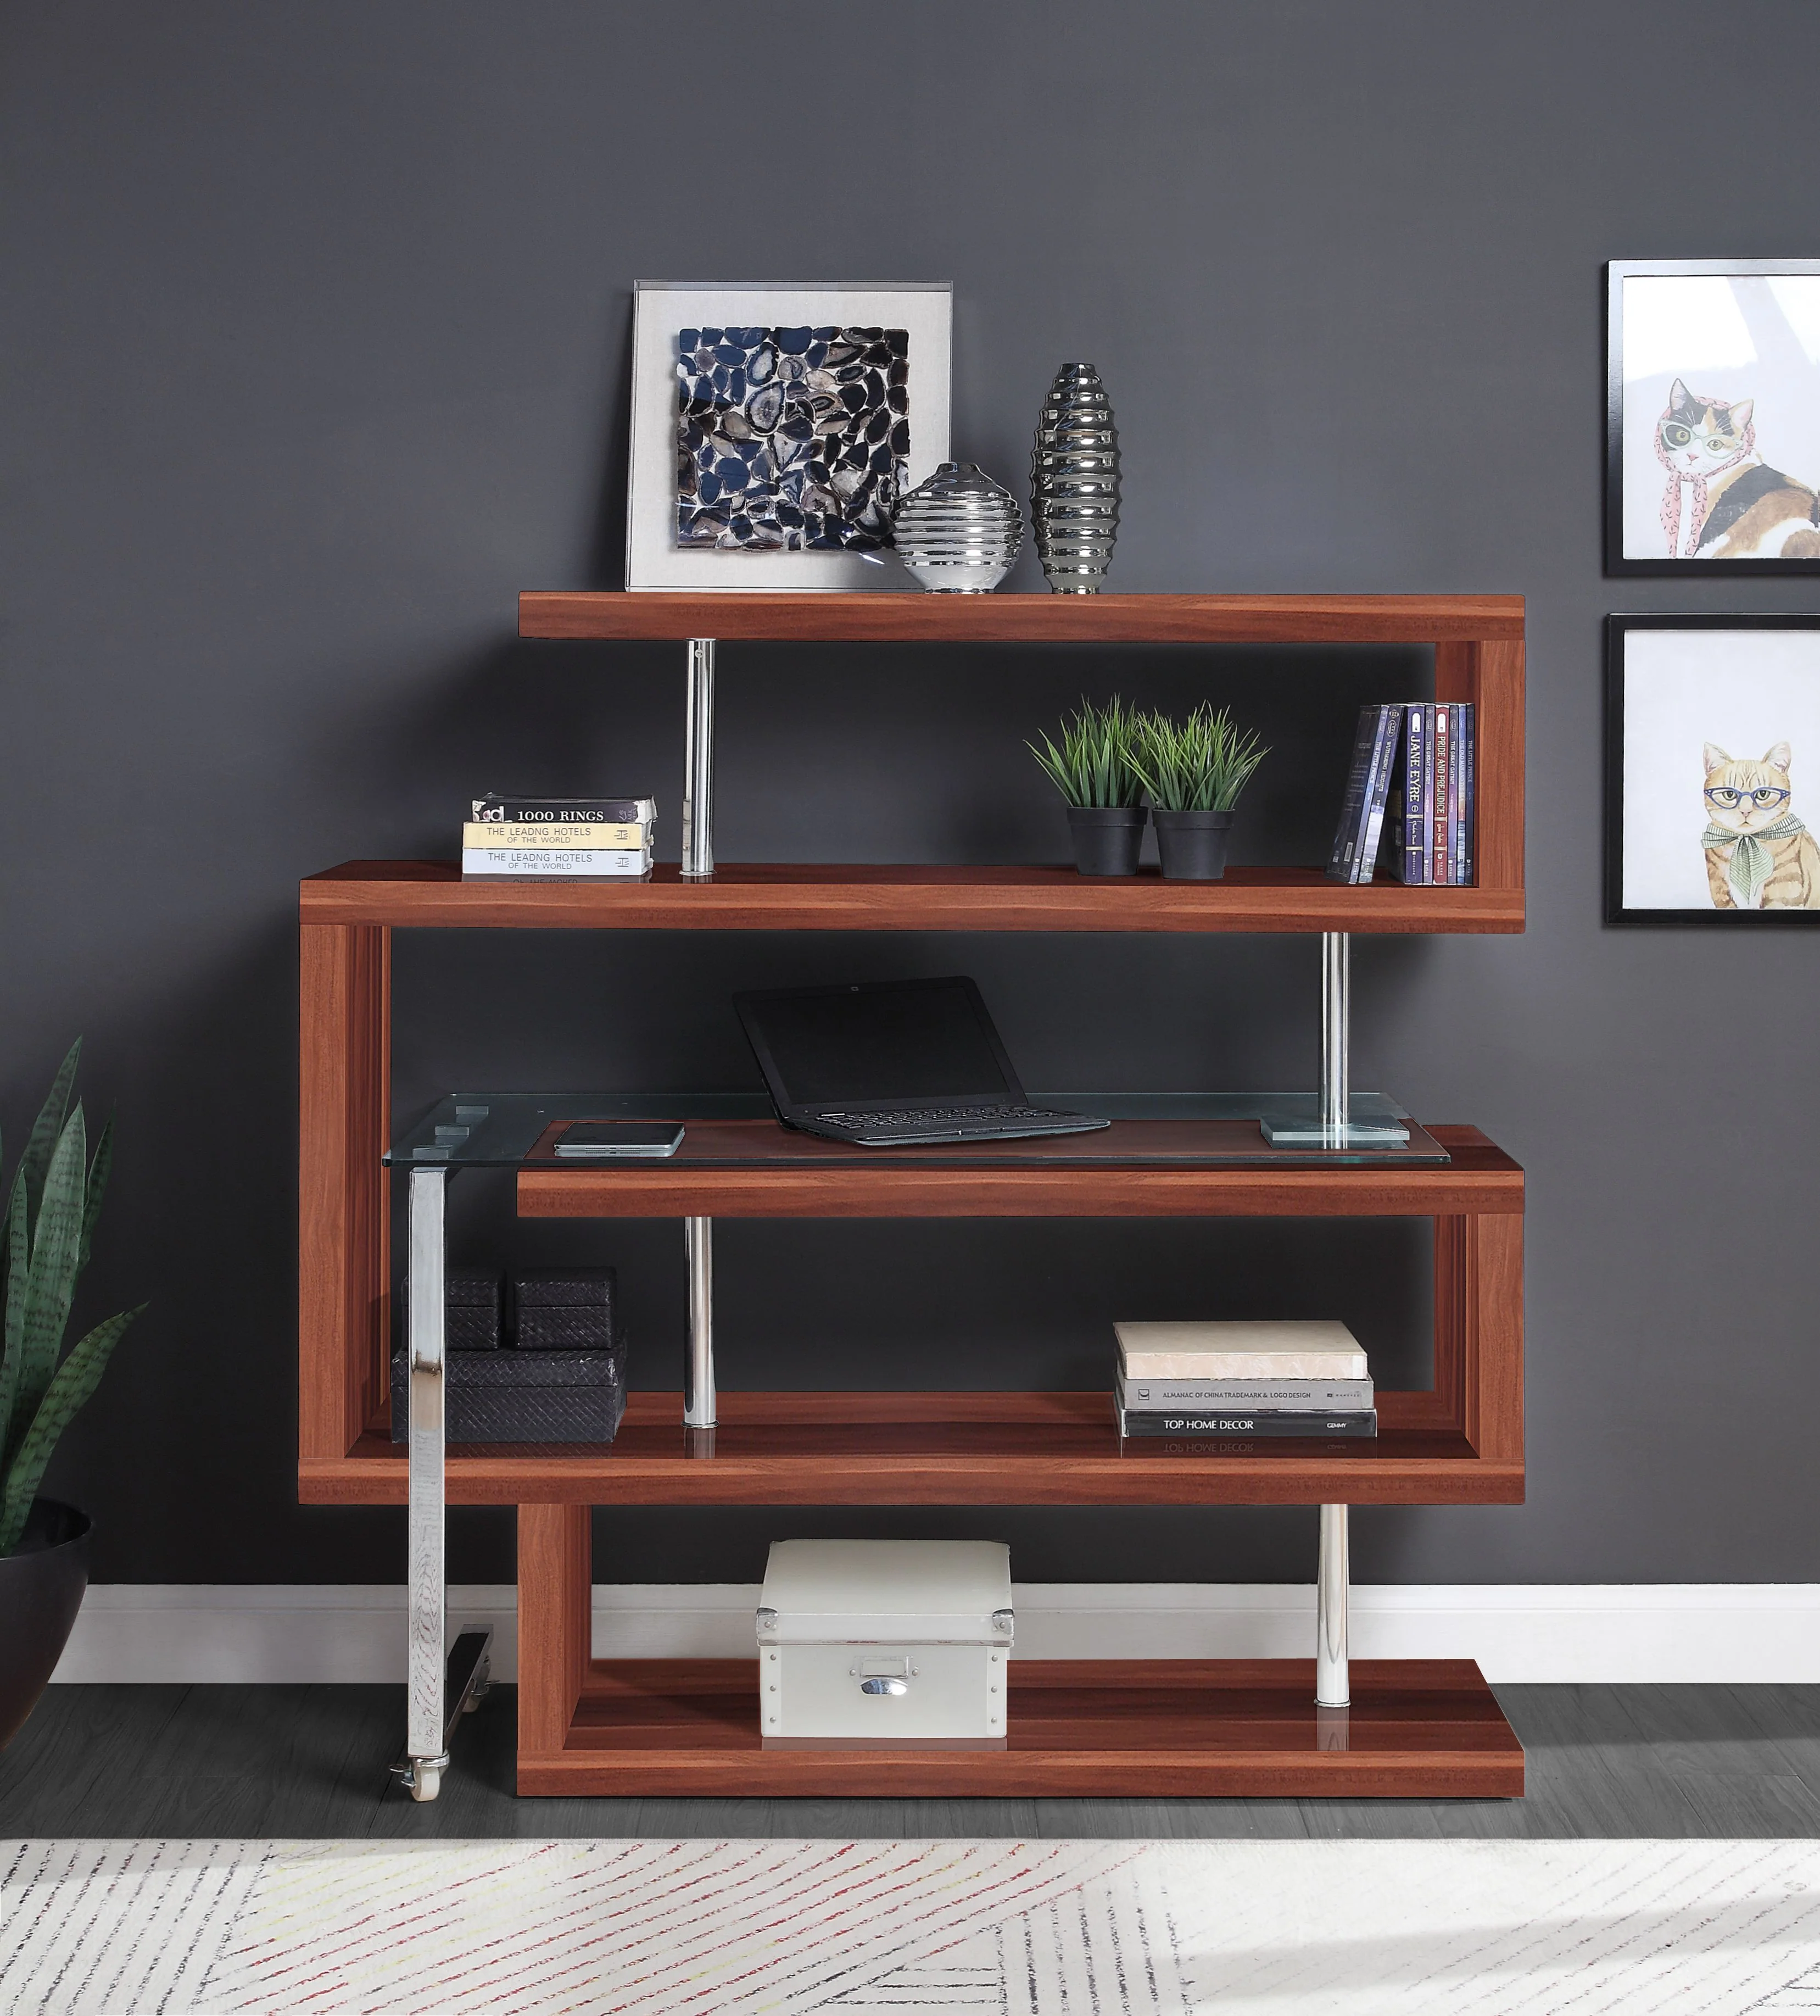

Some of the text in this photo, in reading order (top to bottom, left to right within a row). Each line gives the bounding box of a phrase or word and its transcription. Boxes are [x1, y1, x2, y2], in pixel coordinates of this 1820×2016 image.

[1409, 736, 1421, 802] JANE EYRE
[1436, 736, 1446, 814] PRIDE AND PREJUDICE
[517, 811, 604, 821] 1000 RINGS
[487, 827, 505, 836] THE
[554, 828, 591, 836] HOTELS
[511, 853, 550, 861] LEADNG
[555, 854, 593, 862] HOTELS
[1163, 1420, 1254, 1429] TOP HOME DECOR
